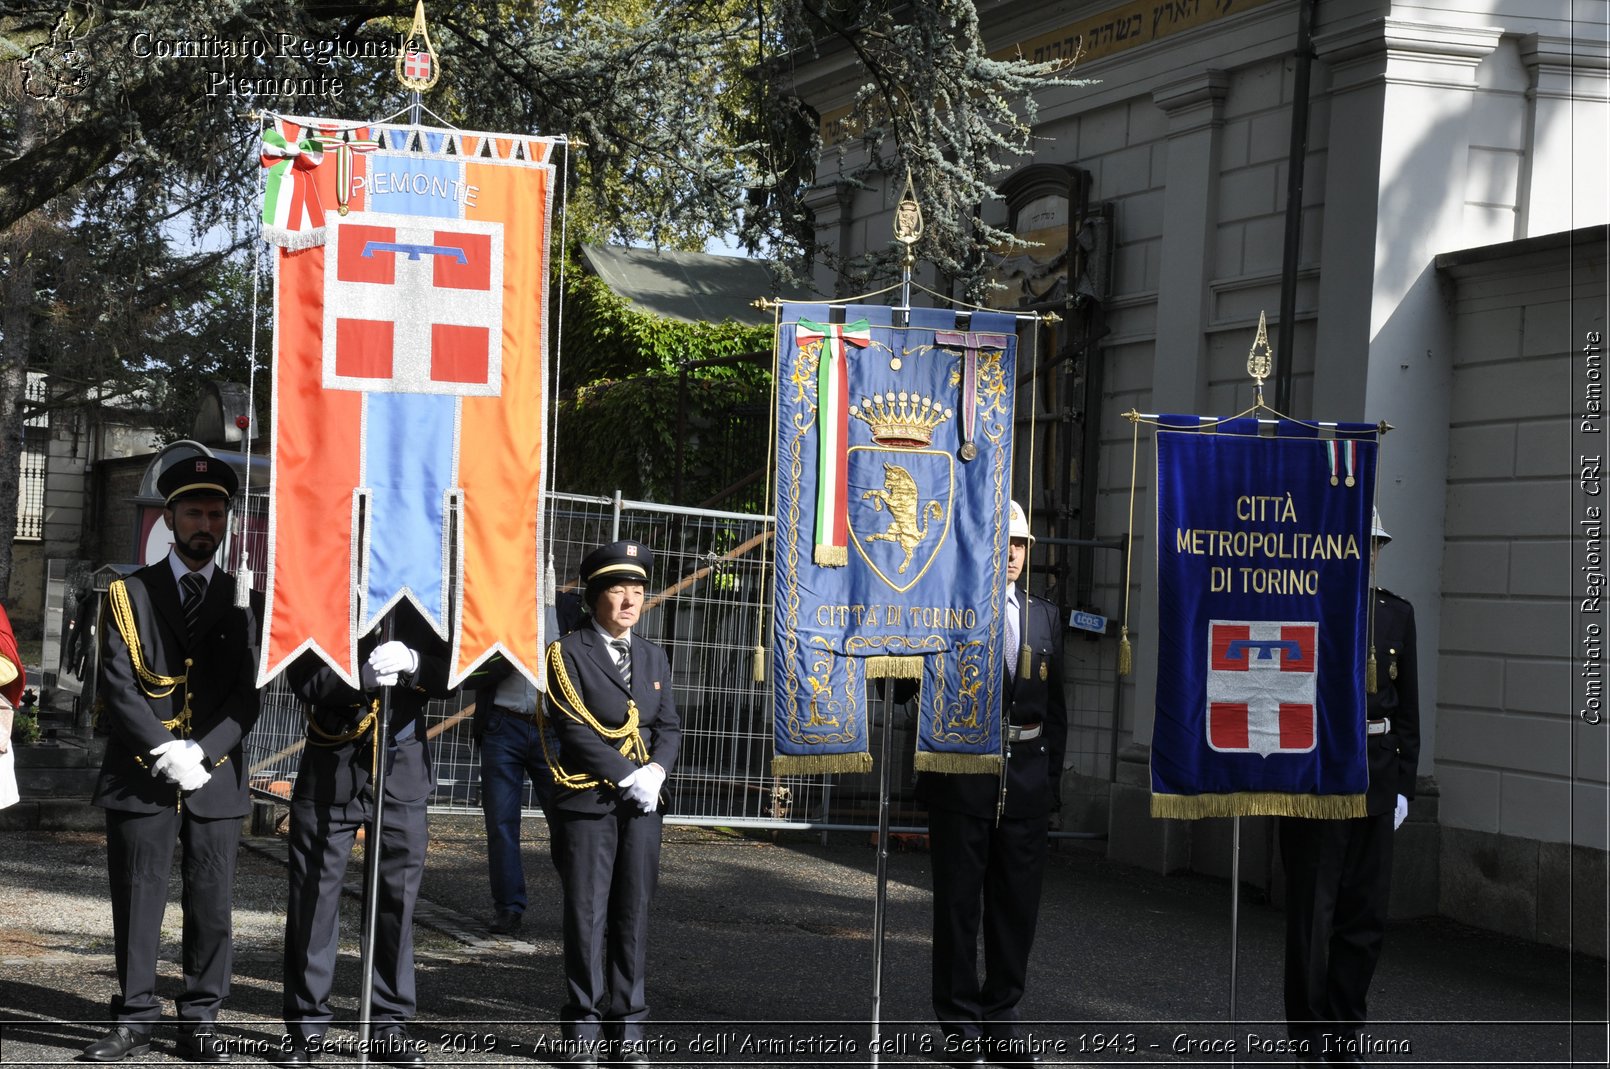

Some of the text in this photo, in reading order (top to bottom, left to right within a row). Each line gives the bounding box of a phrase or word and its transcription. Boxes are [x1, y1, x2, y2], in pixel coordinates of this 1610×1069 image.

[351, 172, 480, 208] PIEMONTE
[1236, 491, 1298, 523] CITTÀ
[1176, 527, 1361, 560] METROPOLITANA
[1210, 566, 1319, 596] DI TORINO
[886, 604, 902, 627] DI
[909, 606, 977, 630] TORINO
